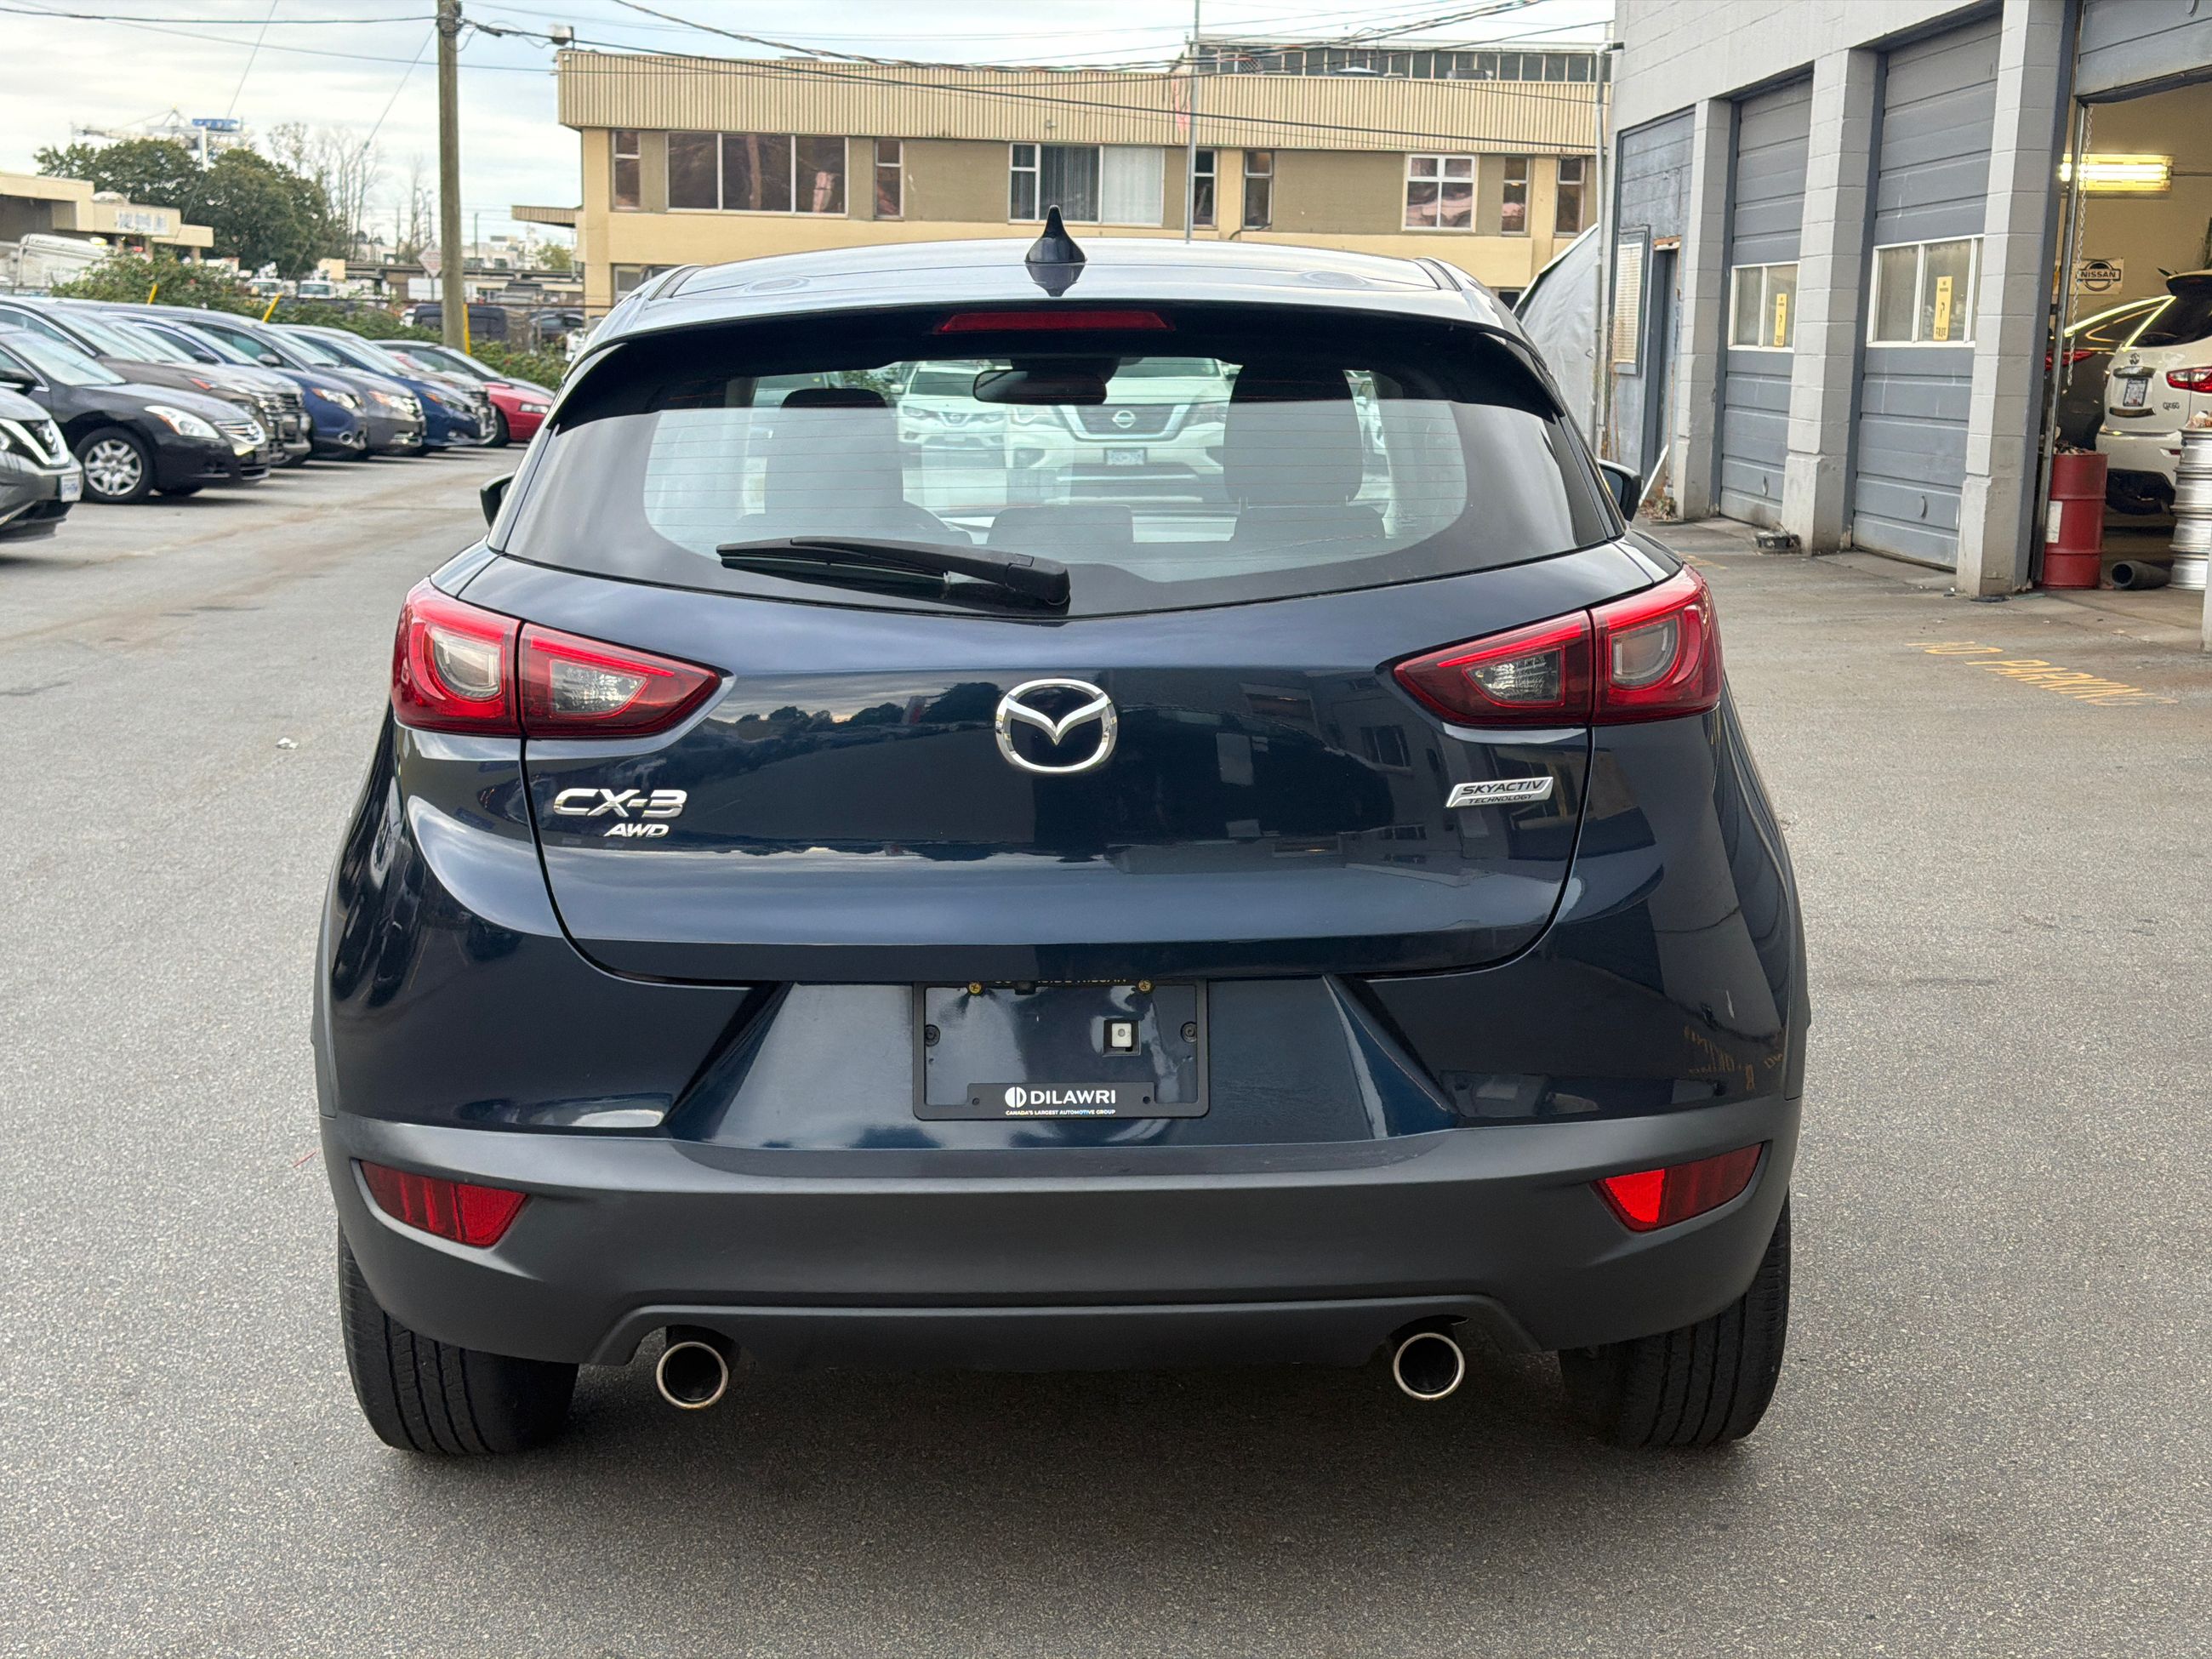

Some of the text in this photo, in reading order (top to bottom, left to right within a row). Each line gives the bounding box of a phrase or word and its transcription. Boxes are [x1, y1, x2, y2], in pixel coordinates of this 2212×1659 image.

[1904, 641, 2180, 706] NO PARKING
[1461, 780, 1545, 795] SKYACTIV
[553, 788, 687, 819] CX-3
[1468, 794, 1534, 804] TECHNOLOGY
[603, 823, 670, 838] AWD
[1030, 1089, 1116, 1104] DILAWRI
